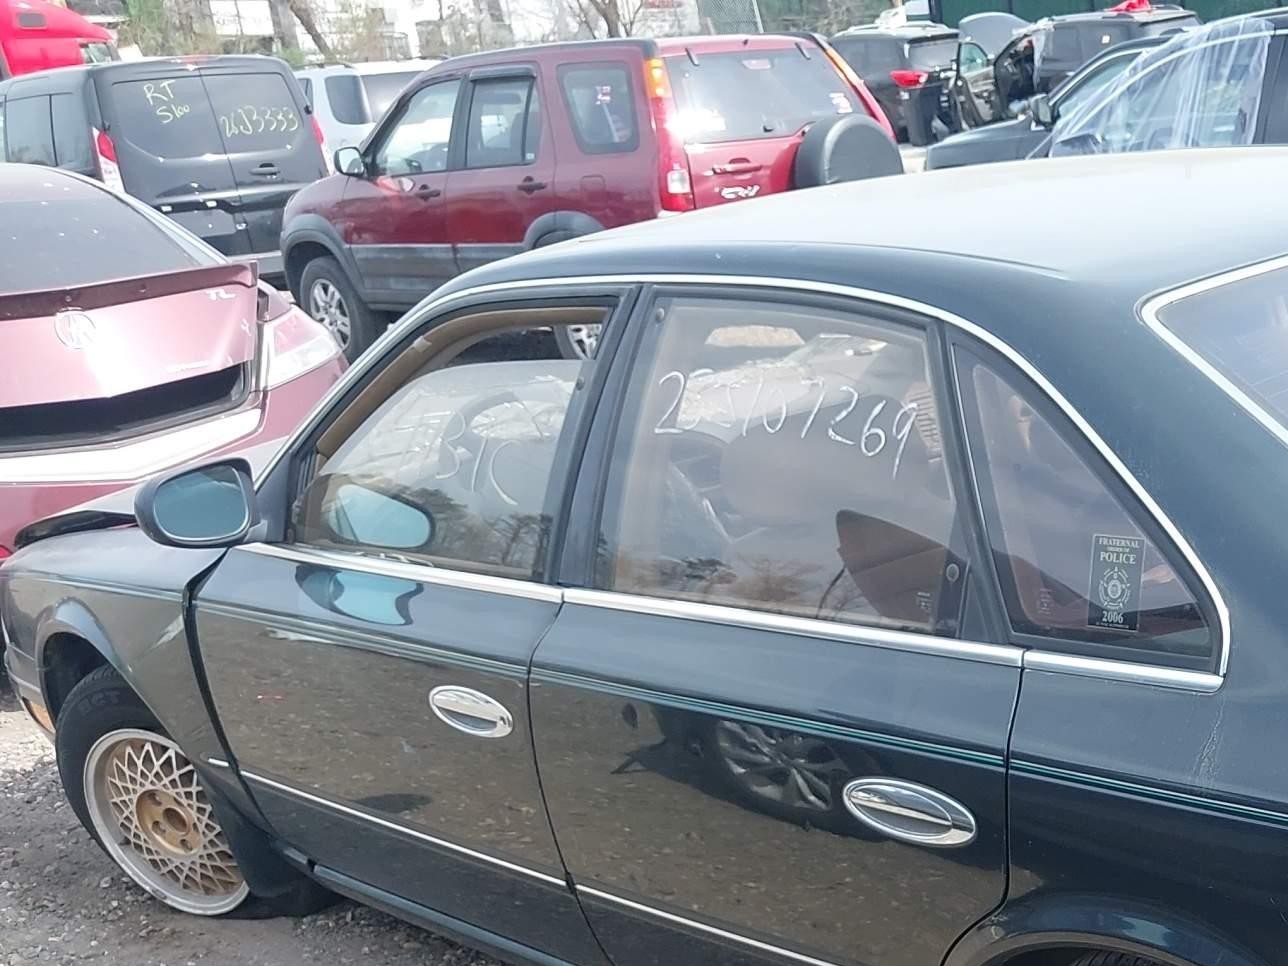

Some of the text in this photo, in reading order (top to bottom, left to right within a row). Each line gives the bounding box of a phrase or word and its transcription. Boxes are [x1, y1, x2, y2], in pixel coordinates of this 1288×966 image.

[143, 80, 176, 105] RT
[1099, 537, 1140, 549] FRATERNAL
[1100, 551, 1137, 565] POLICE
[1102, 610, 1124, 624] 2006
